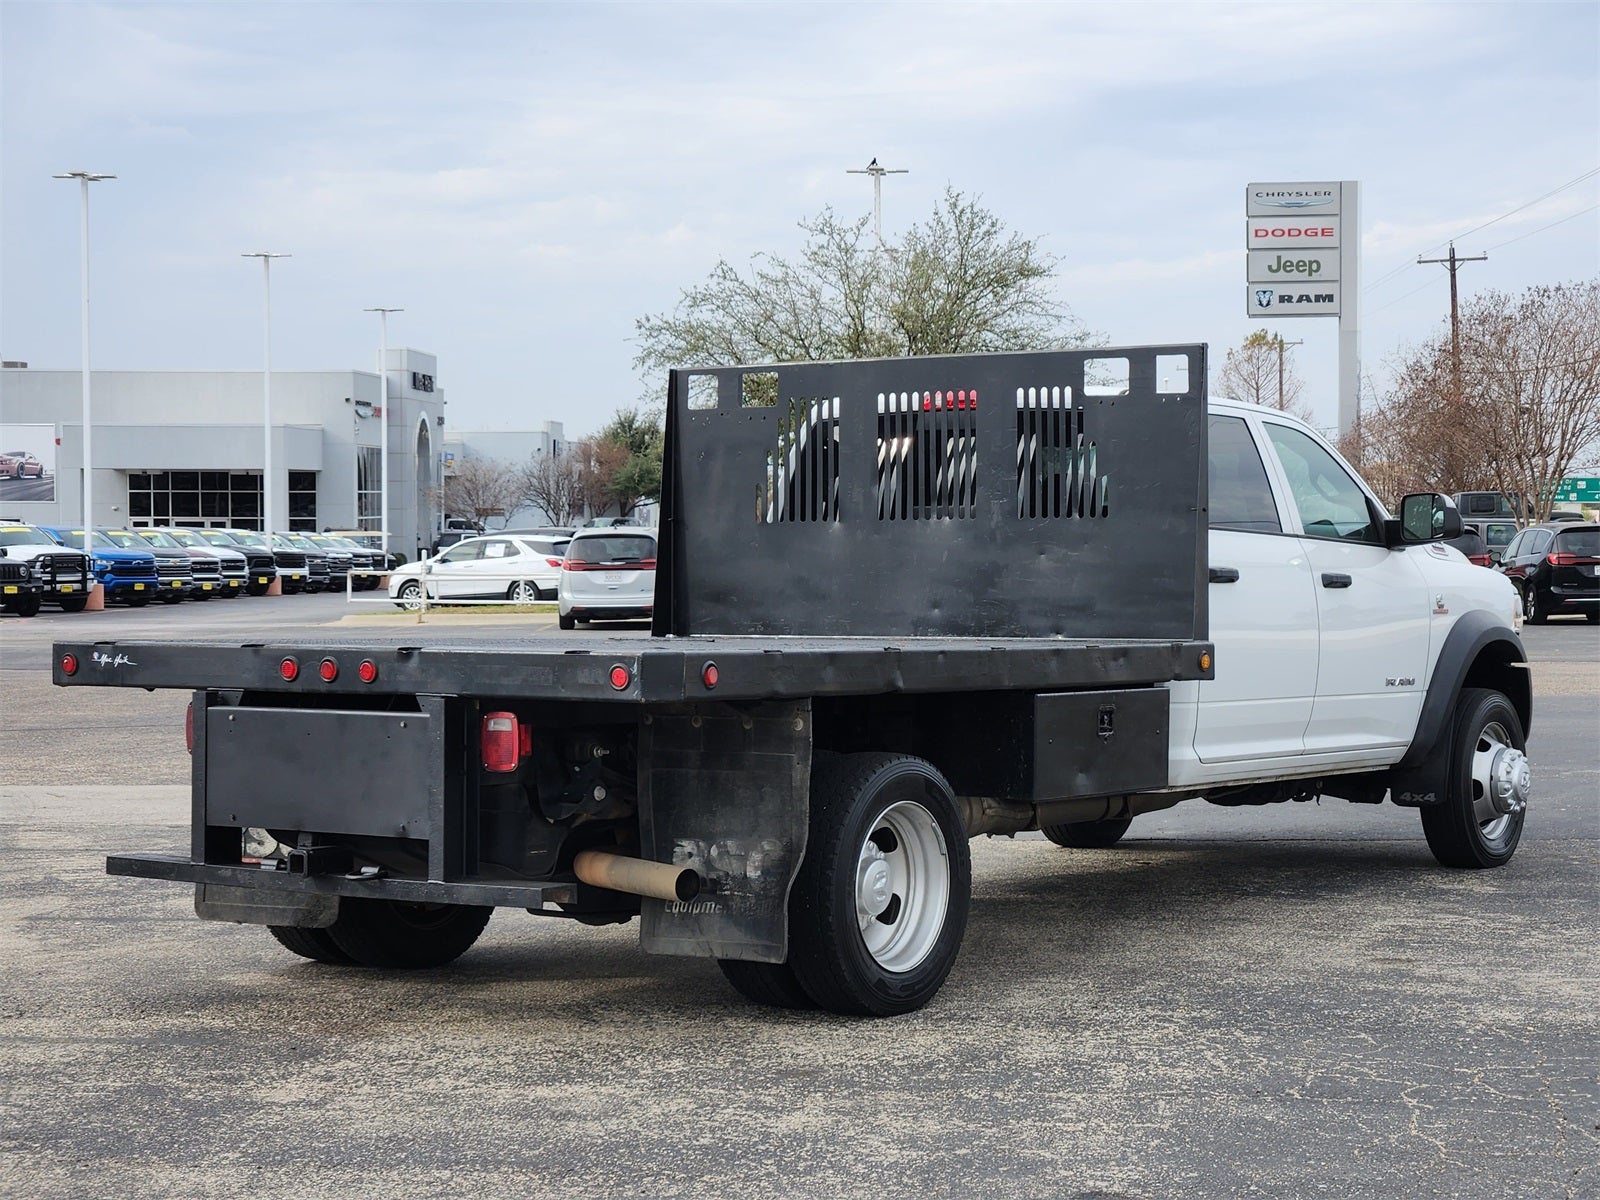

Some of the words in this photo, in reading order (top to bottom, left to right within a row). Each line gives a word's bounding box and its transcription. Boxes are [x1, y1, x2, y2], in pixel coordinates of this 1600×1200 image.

[1254, 228, 1334, 237] DODGE
[1267, 255, 1322, 277] Jeep
[1278, 294, 1334, 304] RAM
[1401, 792, 1436, 801] 4x4
